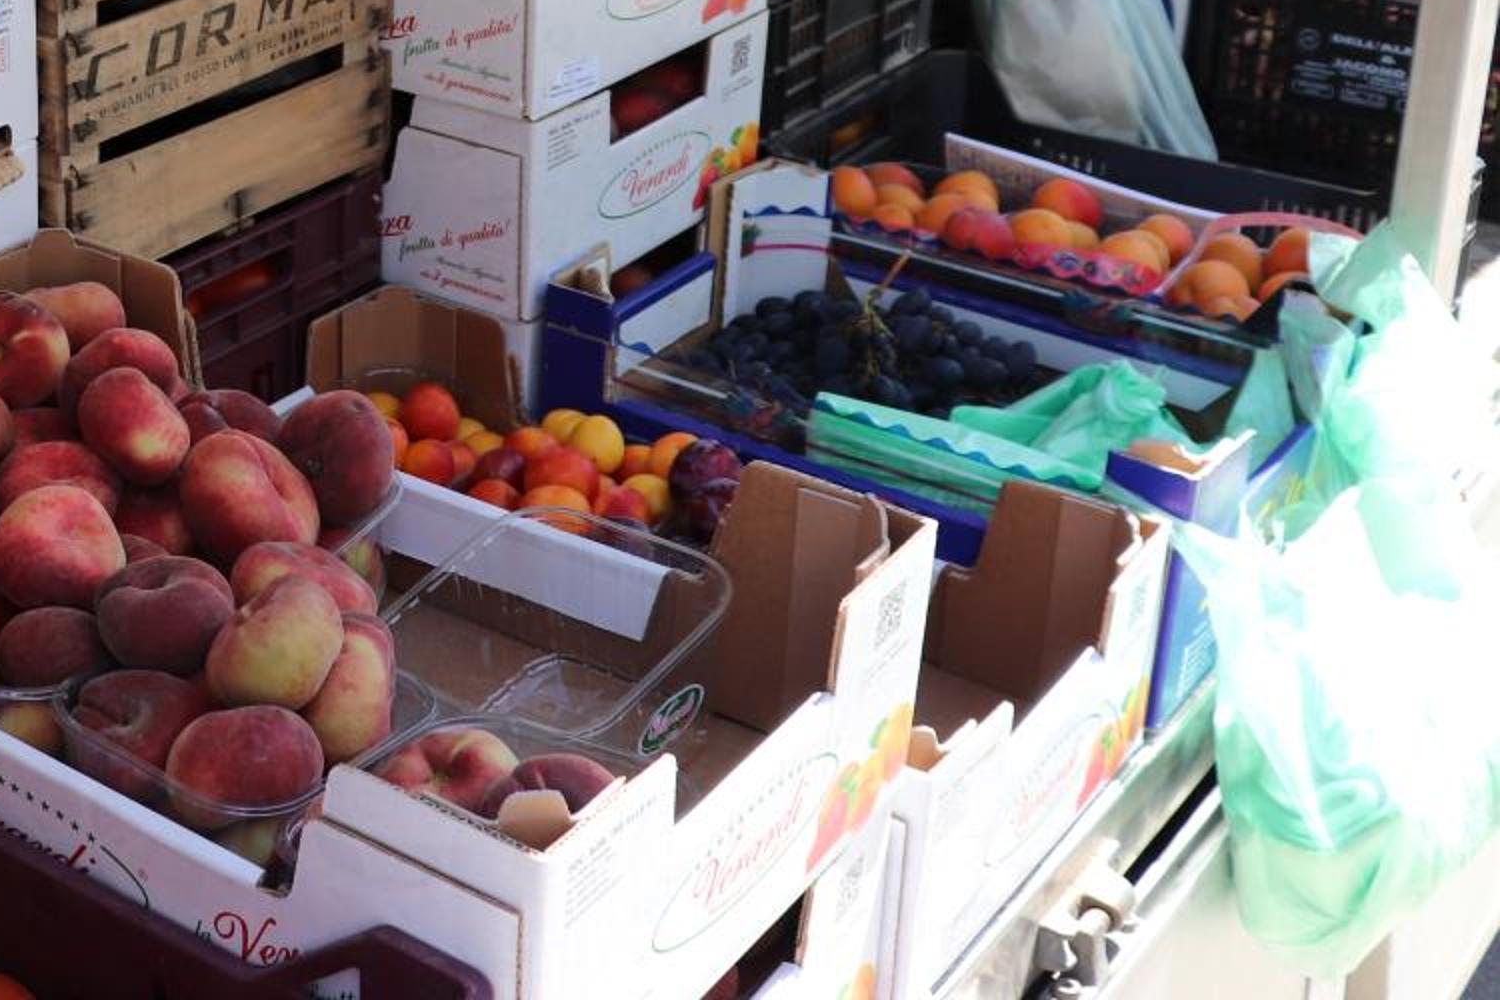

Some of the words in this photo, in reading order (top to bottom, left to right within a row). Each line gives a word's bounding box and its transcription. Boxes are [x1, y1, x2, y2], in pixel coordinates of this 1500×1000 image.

[404, 36, 440, 66] frutta
[446, 28, 458, 47] di
[621, 140, 693, 202] Verardi
[399, 236, 435, 262] frutta
[440, 228, 453, 247] di
